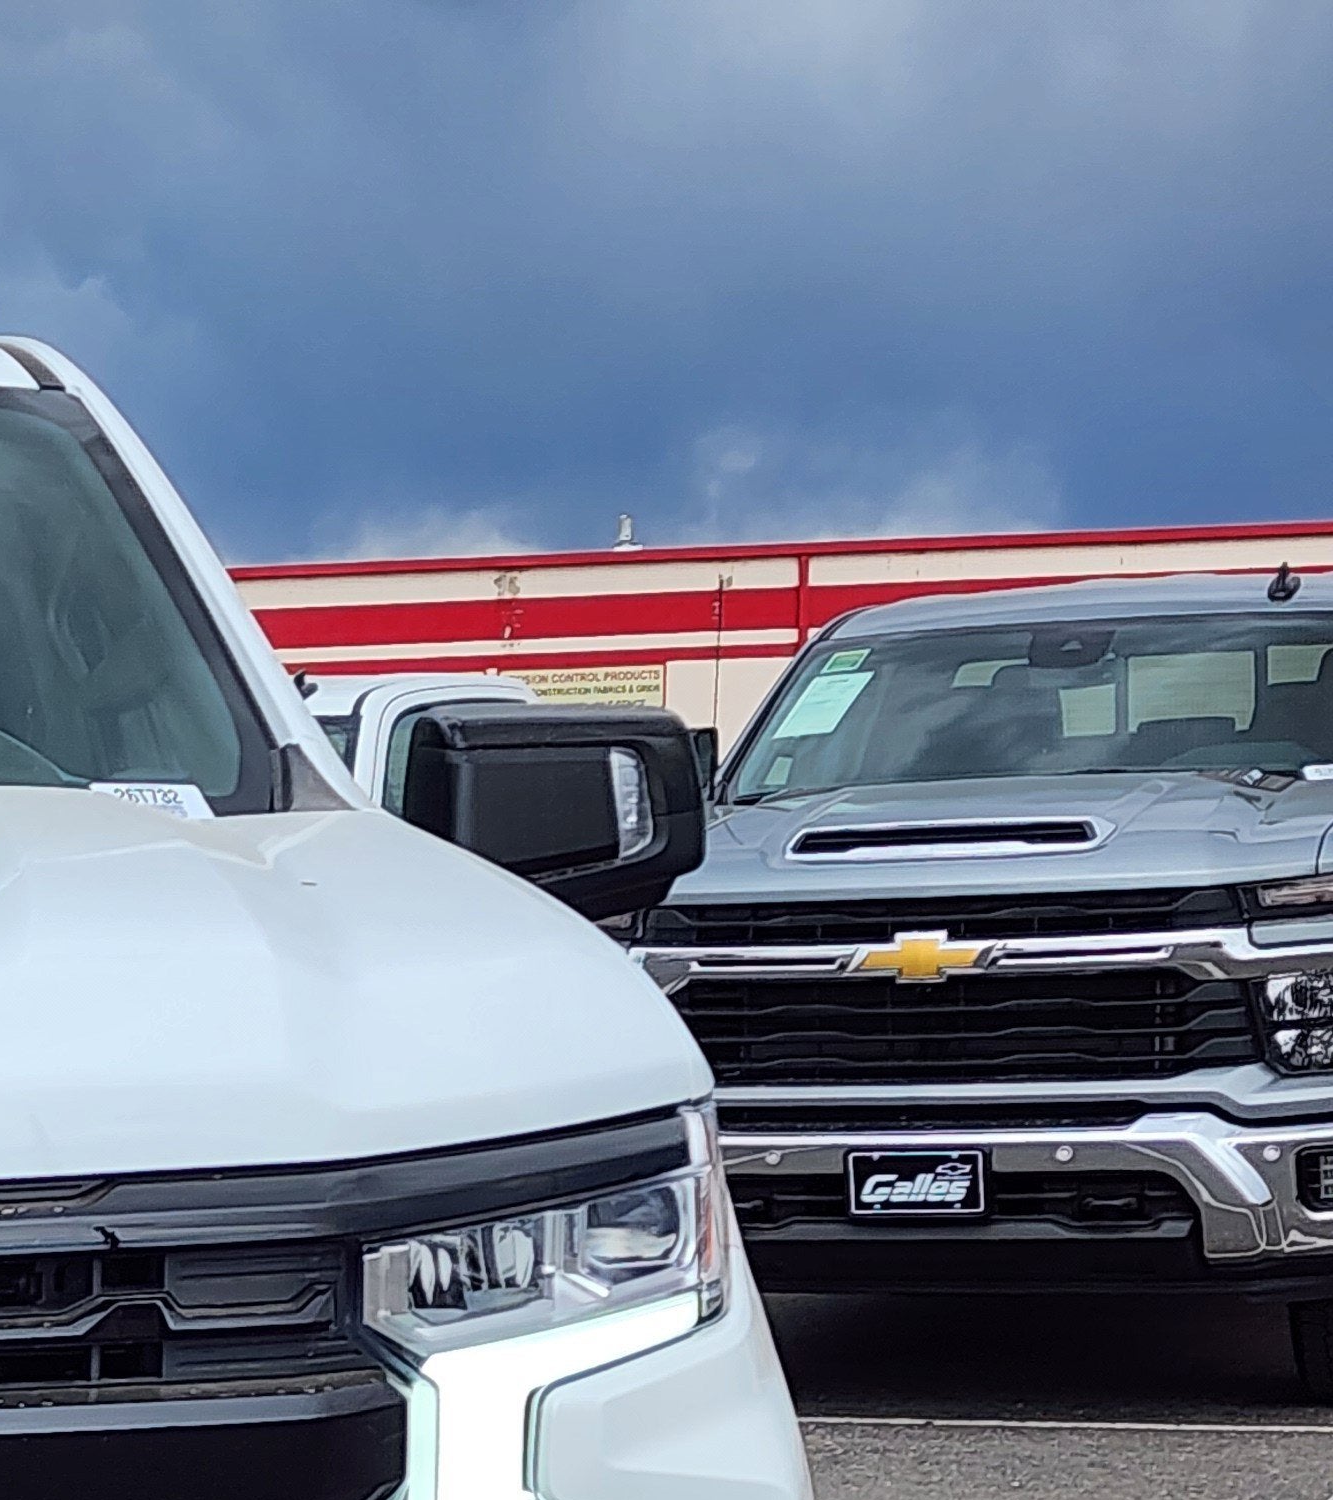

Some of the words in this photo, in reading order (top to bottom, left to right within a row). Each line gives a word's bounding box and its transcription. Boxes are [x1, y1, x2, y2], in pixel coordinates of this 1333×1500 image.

[551, 673, 600, 684] CONTROL
[603, 670, 660, 682] PRODUCTS
[532, 686, 591, 697] ONSTRUCTION
[860, 1173, 970, 1203] Galles
